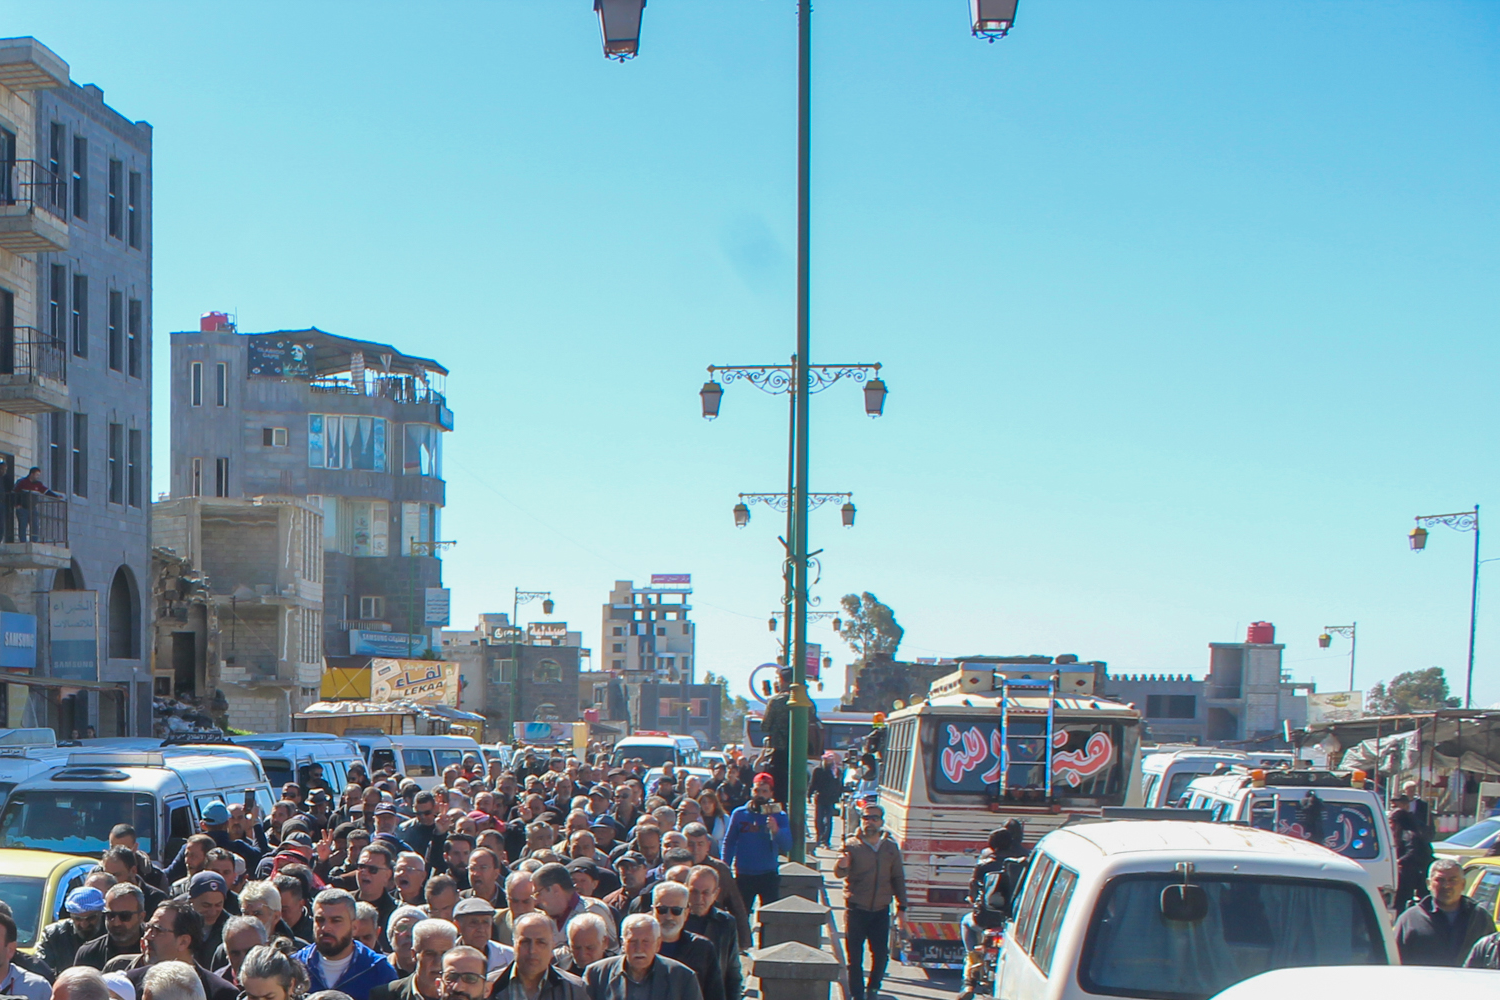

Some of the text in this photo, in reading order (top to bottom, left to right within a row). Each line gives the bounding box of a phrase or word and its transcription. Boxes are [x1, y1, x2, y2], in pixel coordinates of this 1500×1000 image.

[54, 600, 93, 615] الخبراء
[54, 619, 93, 628] للاتصالات
[529, 623, 567, 639] صيدلية
[4, 631, 35, 648] SAMSUNG
[362, 633, 388, 642] SAMSUNG
[54, 660, 94, 669] SAMSUNG
[395, 664, 442, 688] لقاء
[403, 681, 443, 696] LEKAA
